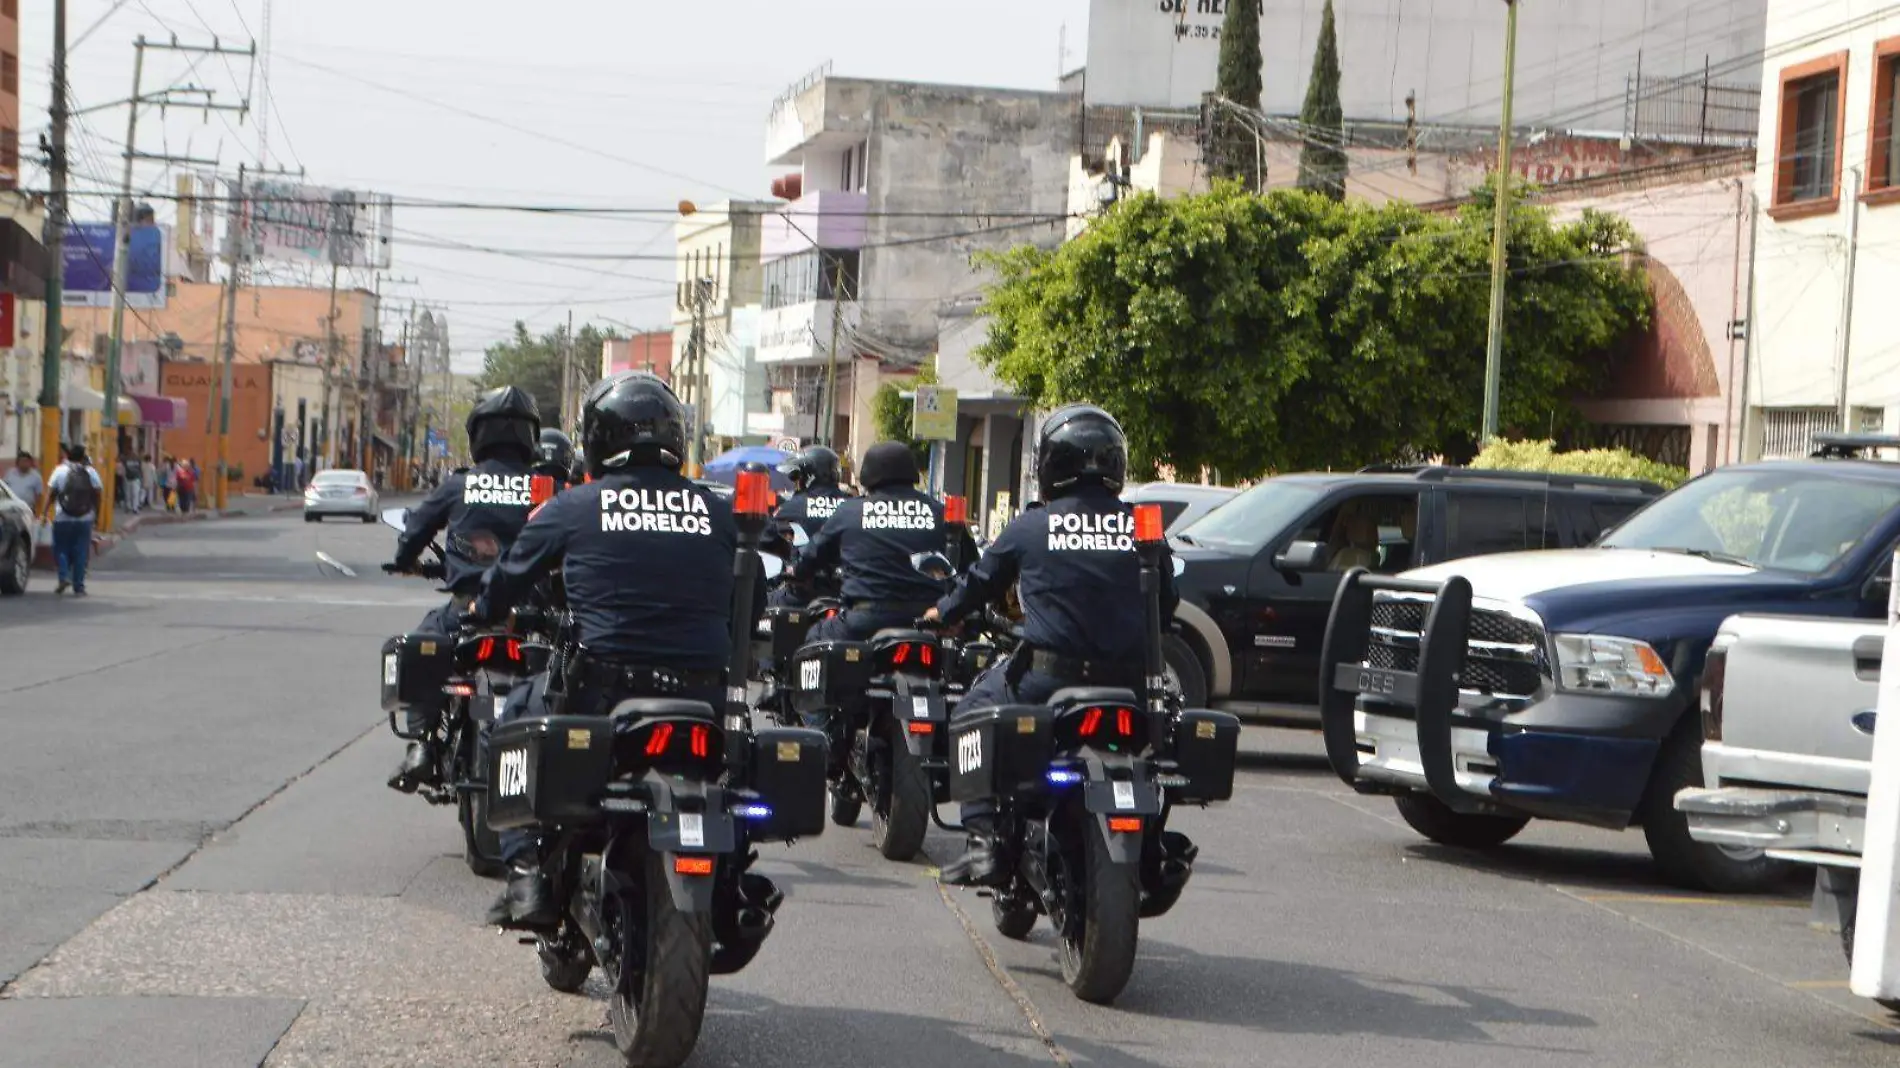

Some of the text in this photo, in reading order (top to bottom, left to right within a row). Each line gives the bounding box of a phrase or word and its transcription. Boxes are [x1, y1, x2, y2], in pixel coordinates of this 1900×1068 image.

[465, 474, 531, 490] POLICÍ
[464, 489, 531, 506] MORELO
[601, 489, 708, 514] POLICÍA
[862, 500, 933, 516] POLICÍA
[601, 512, 712, 536] MORELOS
[861, 515, 935, 530] MORELOS
[1048, 533, 1136, 551] MORELO
[499, 748, 527, 797] 07234
